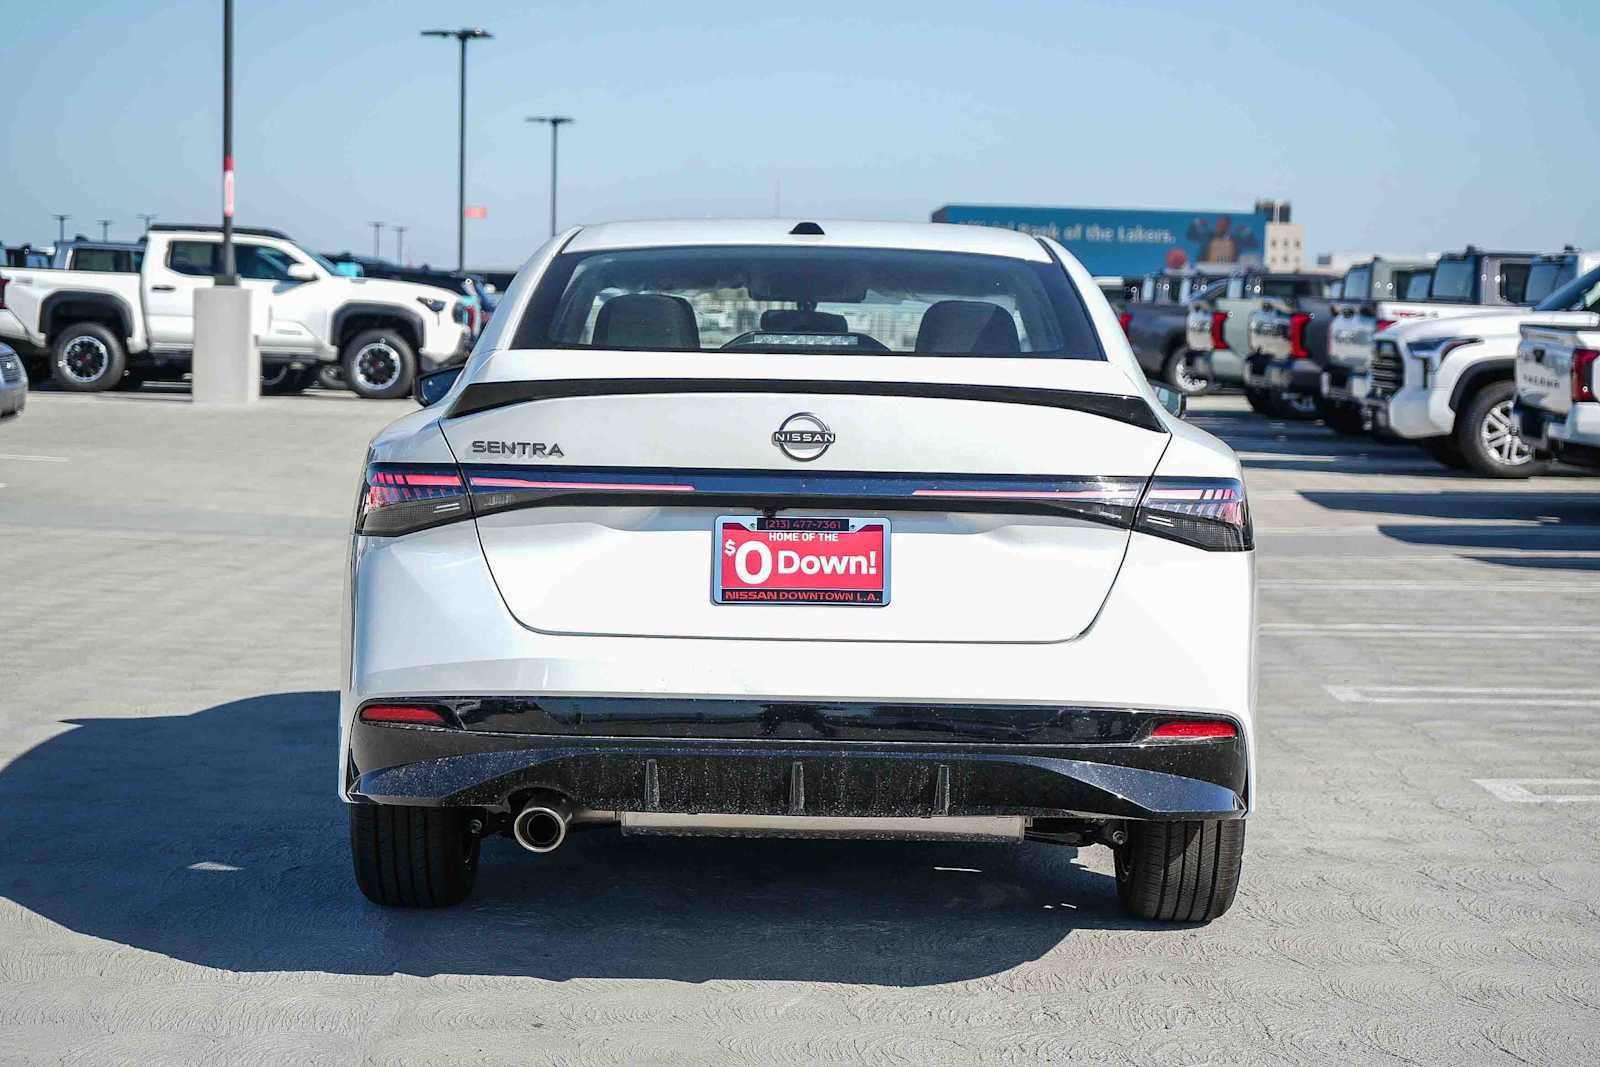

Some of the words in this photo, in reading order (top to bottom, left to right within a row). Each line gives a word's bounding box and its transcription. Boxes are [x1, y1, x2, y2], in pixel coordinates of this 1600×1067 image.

[1063, 222, 1083, 240] of
[1085, 222, 1114, 241] the
[775, 433, 835, 442] NISSAN
[472, 440, 565, 457] SENTRA
[768, 532, 800, 542] HOME
[801, 532, 816, 542] OF
[818, 533, 839, 542] THE
[777, 550, 877, 575] Down!
[725, 591, 777, 600] NISSAN
[779, 591, 853, 601] DOWNTOWN
[856, 592, 880, 601] L.A.
